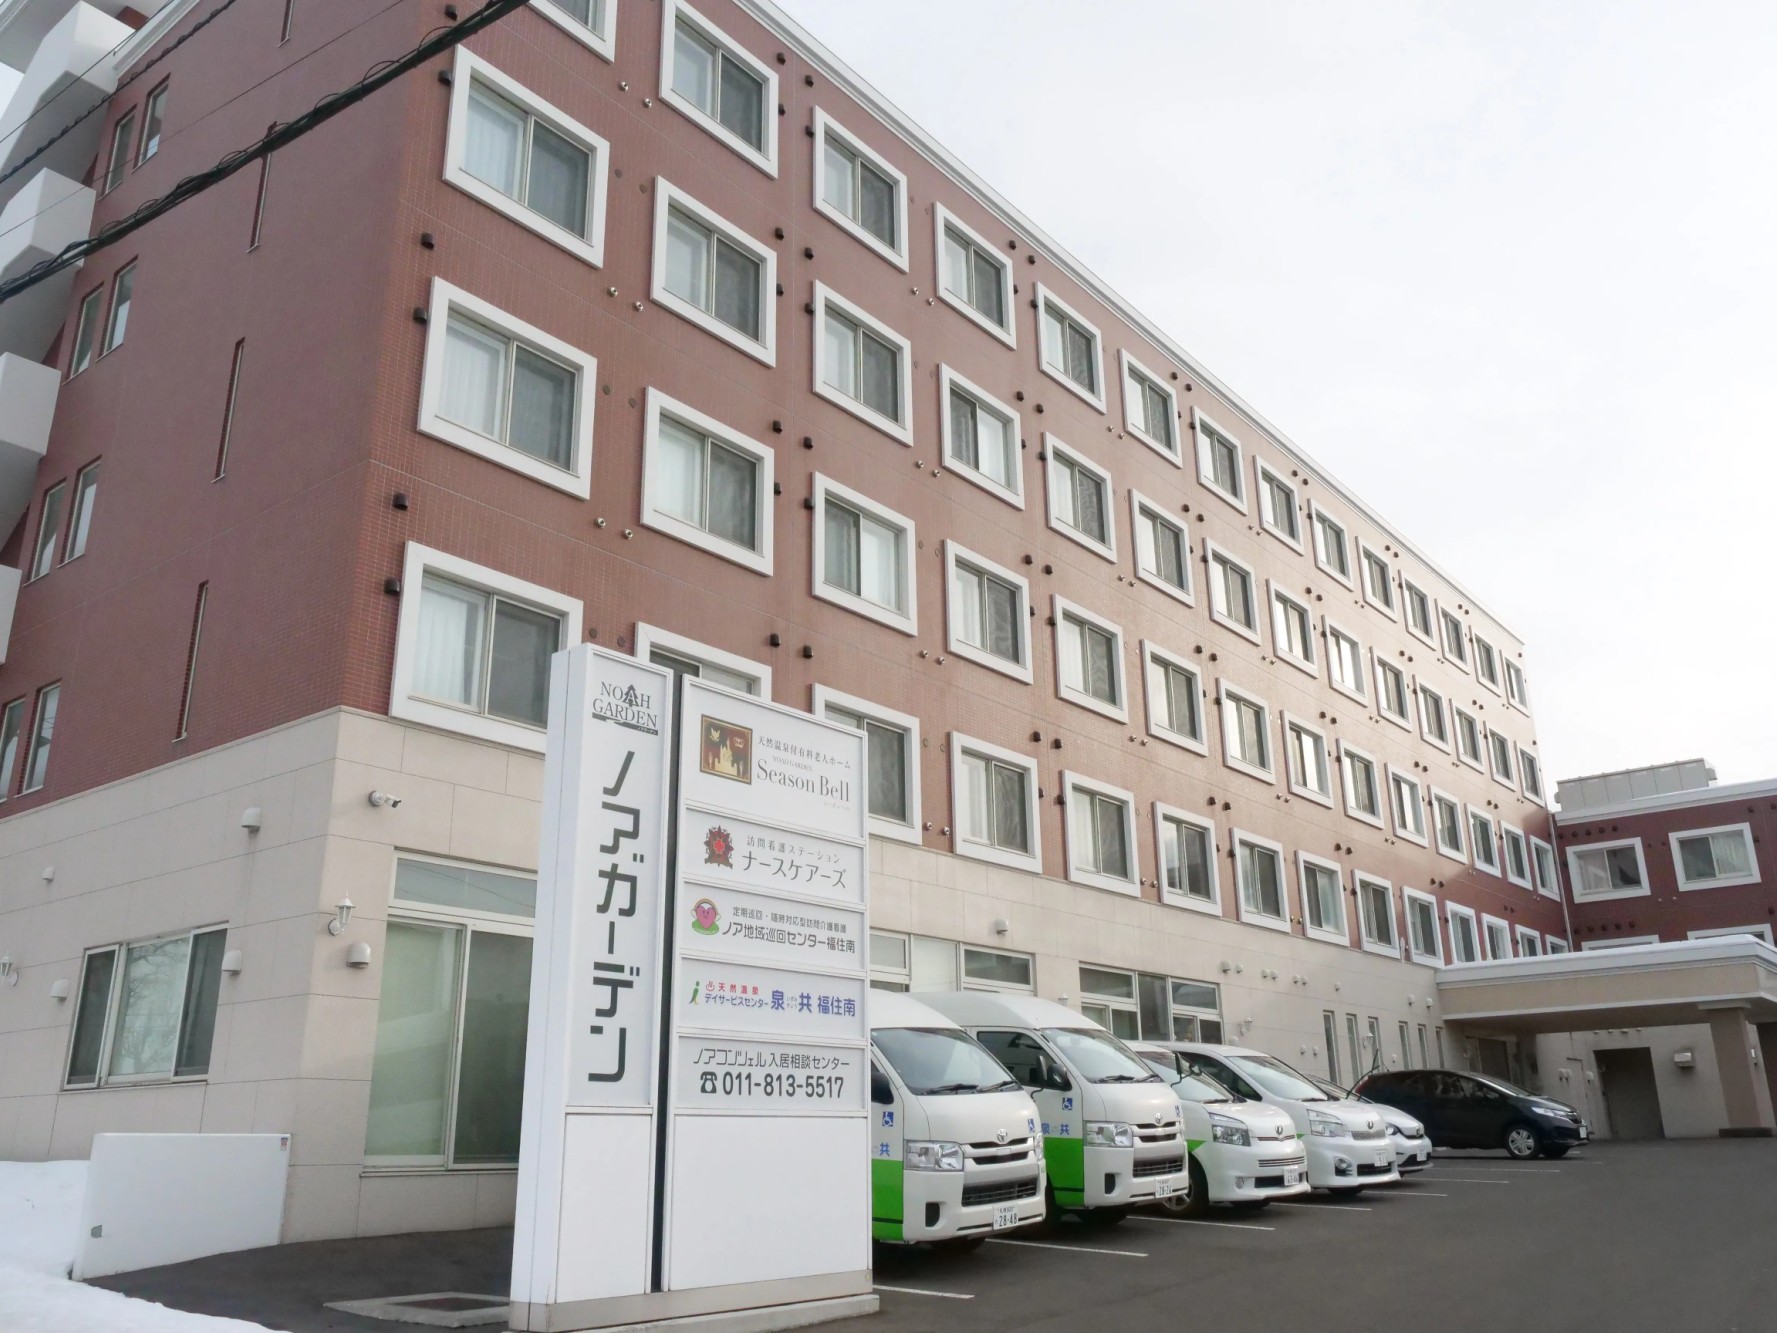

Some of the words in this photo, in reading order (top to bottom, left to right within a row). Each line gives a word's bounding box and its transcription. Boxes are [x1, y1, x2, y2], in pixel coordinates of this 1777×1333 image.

[601, 681, 651, 709] NOAH
[592, 698, 658, 728] GARDEN
[758, 736, 851, 769] 天然温泉付有料老人ホーム
[757, 759, 815, 793] Season
[820, 775, 849, 802] Bell
[747, 835, 840, 864] 訪問看護ステーション
[742, 850, 846, 889] ナースケアーズ
[588, 750, 645, 1082] ノアガーデン
[722, 921, 855, 954] ノア地域巡回センター福住南
[718, 982, 759, 996] 天然温泉
[817, 994, 856, 1017] 福住南
[768, 1052, 850, 1071] 入居相談センター
[722, 1071, 844, 1099] 011-813-5517
[1059, 1122, 1070, 1136] 共
[879, 1142, 890, 1157] 共
